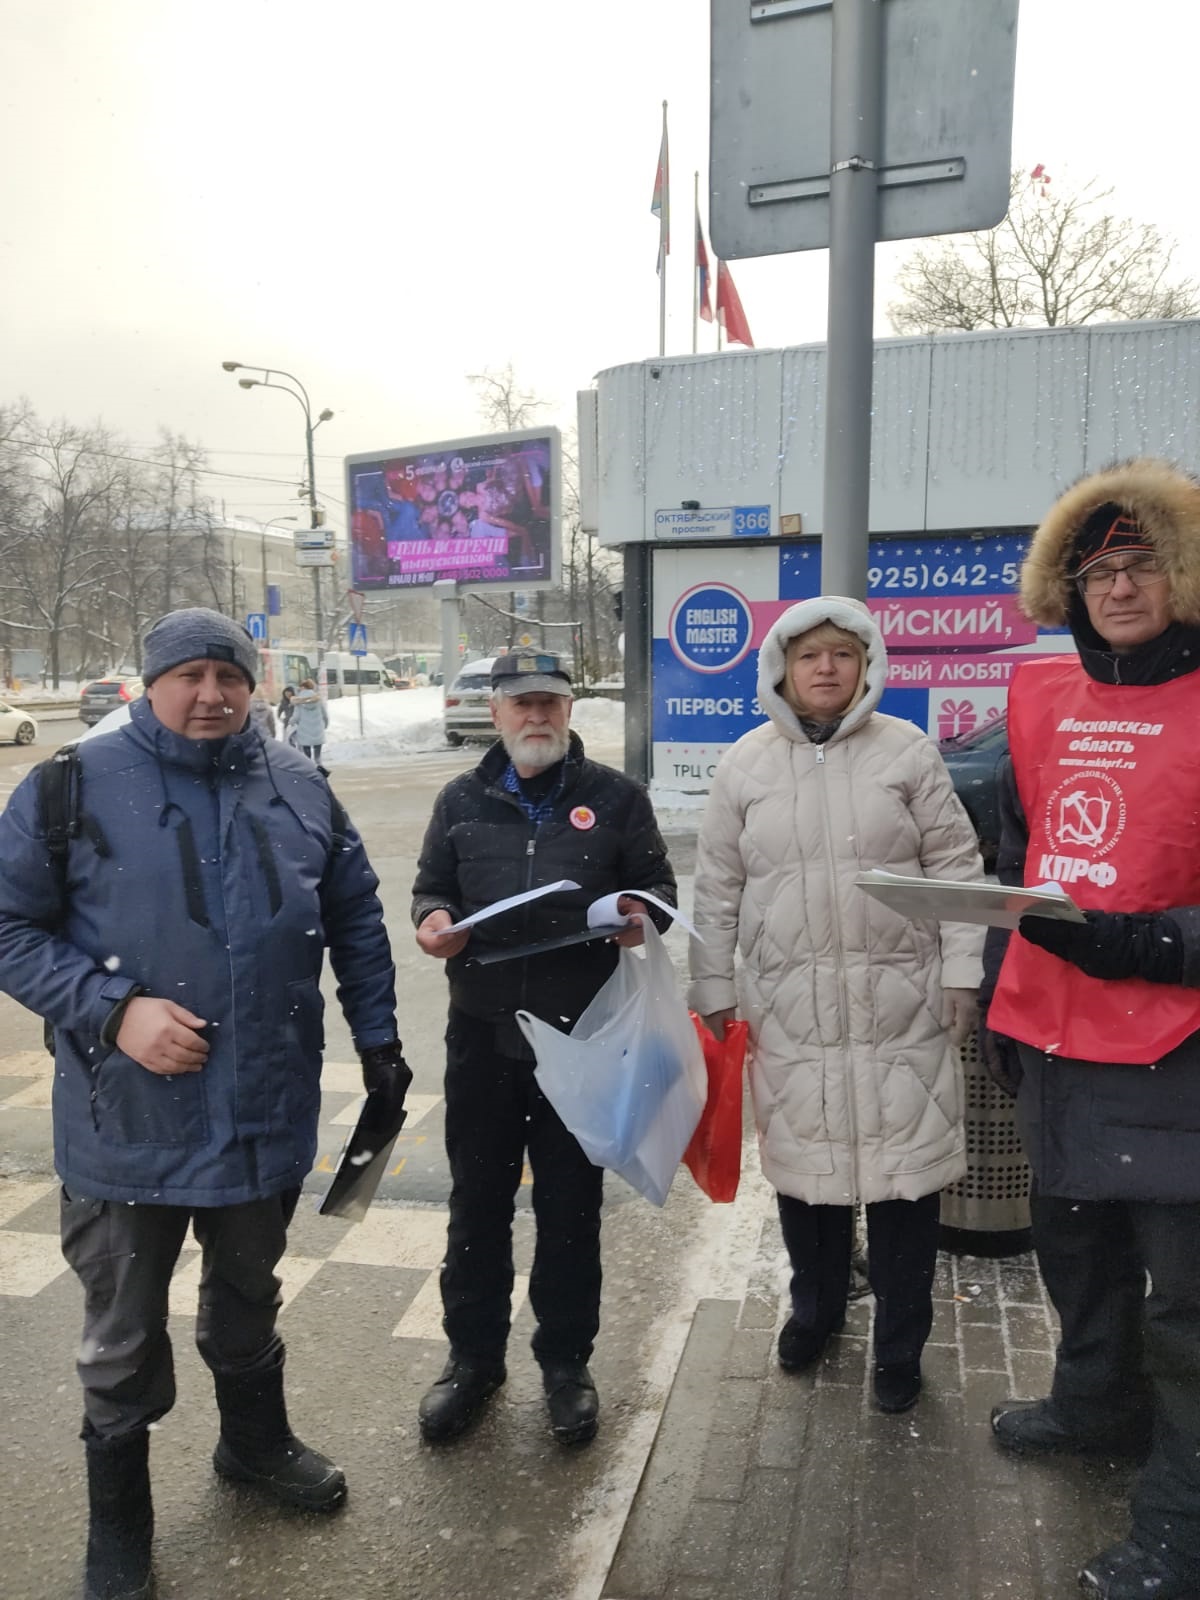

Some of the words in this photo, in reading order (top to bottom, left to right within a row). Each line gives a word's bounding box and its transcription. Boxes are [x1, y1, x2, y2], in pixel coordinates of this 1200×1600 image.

[656, 511, 731, 524] ОКТЯБРЬСКИЙ
[735, 511, 768, 530] 366
[672, 525, 716, 534] проспект
[686, 608, 738, 625] ENGLISH
[686, 628, 738, 644] MASTER
[887, 660, 932, 681] РЫЙ
[939, 662, 1014, 680] ЛЮБЯТ
[667, 697, 744, 716] ПЕРВОЕ
[1056, 717, 1164, 736] Московская
[1068, 736, 1135, 753] область
[673, 764, 701, 778] ТРЦ
[1038, 853, 1117, 888] КПРФ
